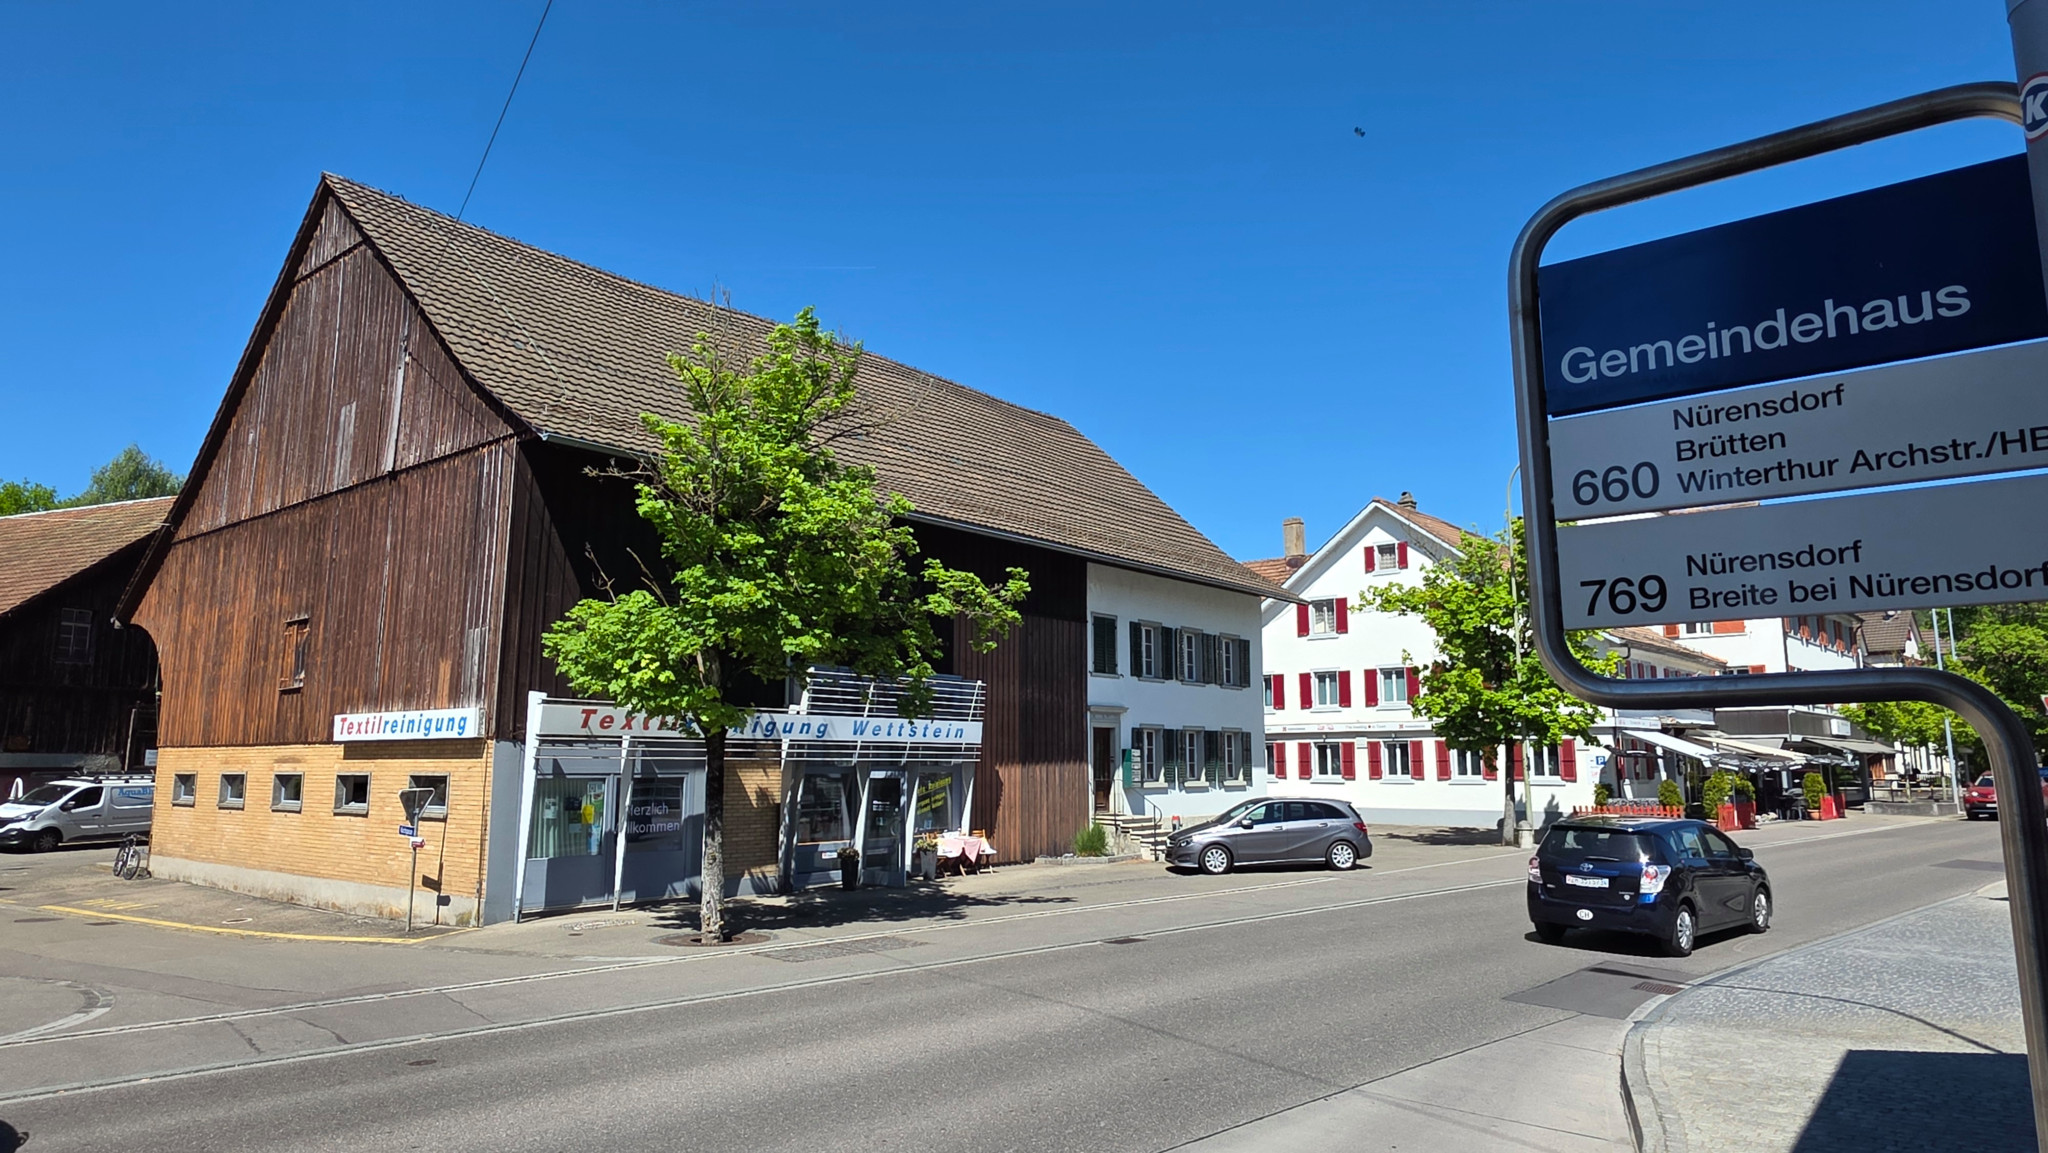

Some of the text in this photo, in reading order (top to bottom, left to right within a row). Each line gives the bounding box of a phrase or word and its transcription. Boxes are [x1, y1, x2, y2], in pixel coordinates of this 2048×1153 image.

[2025, 90, 2048, 125] K
[1560, 284, 1972, 385] Gemeindehaus
[1673, 383, 1845, 430] Nürensdorf
[1676, 431, 1786, 462] Brütten
[1572, 461, 1660, 506] 660
[1677, 458, 1839, 494] Winterthur
[1686, 540, 1862, 577] Nürensdorf
[1580, 575, 1668, 617] 769
[1689, 560, 2048, 610] Breite bei Nürensdorf
[340, 713, 468, 737] Textilreinigung
[580, 708, 965, 739] Textiigung Wettstein
[626, 821, 681, 834] llkommen
